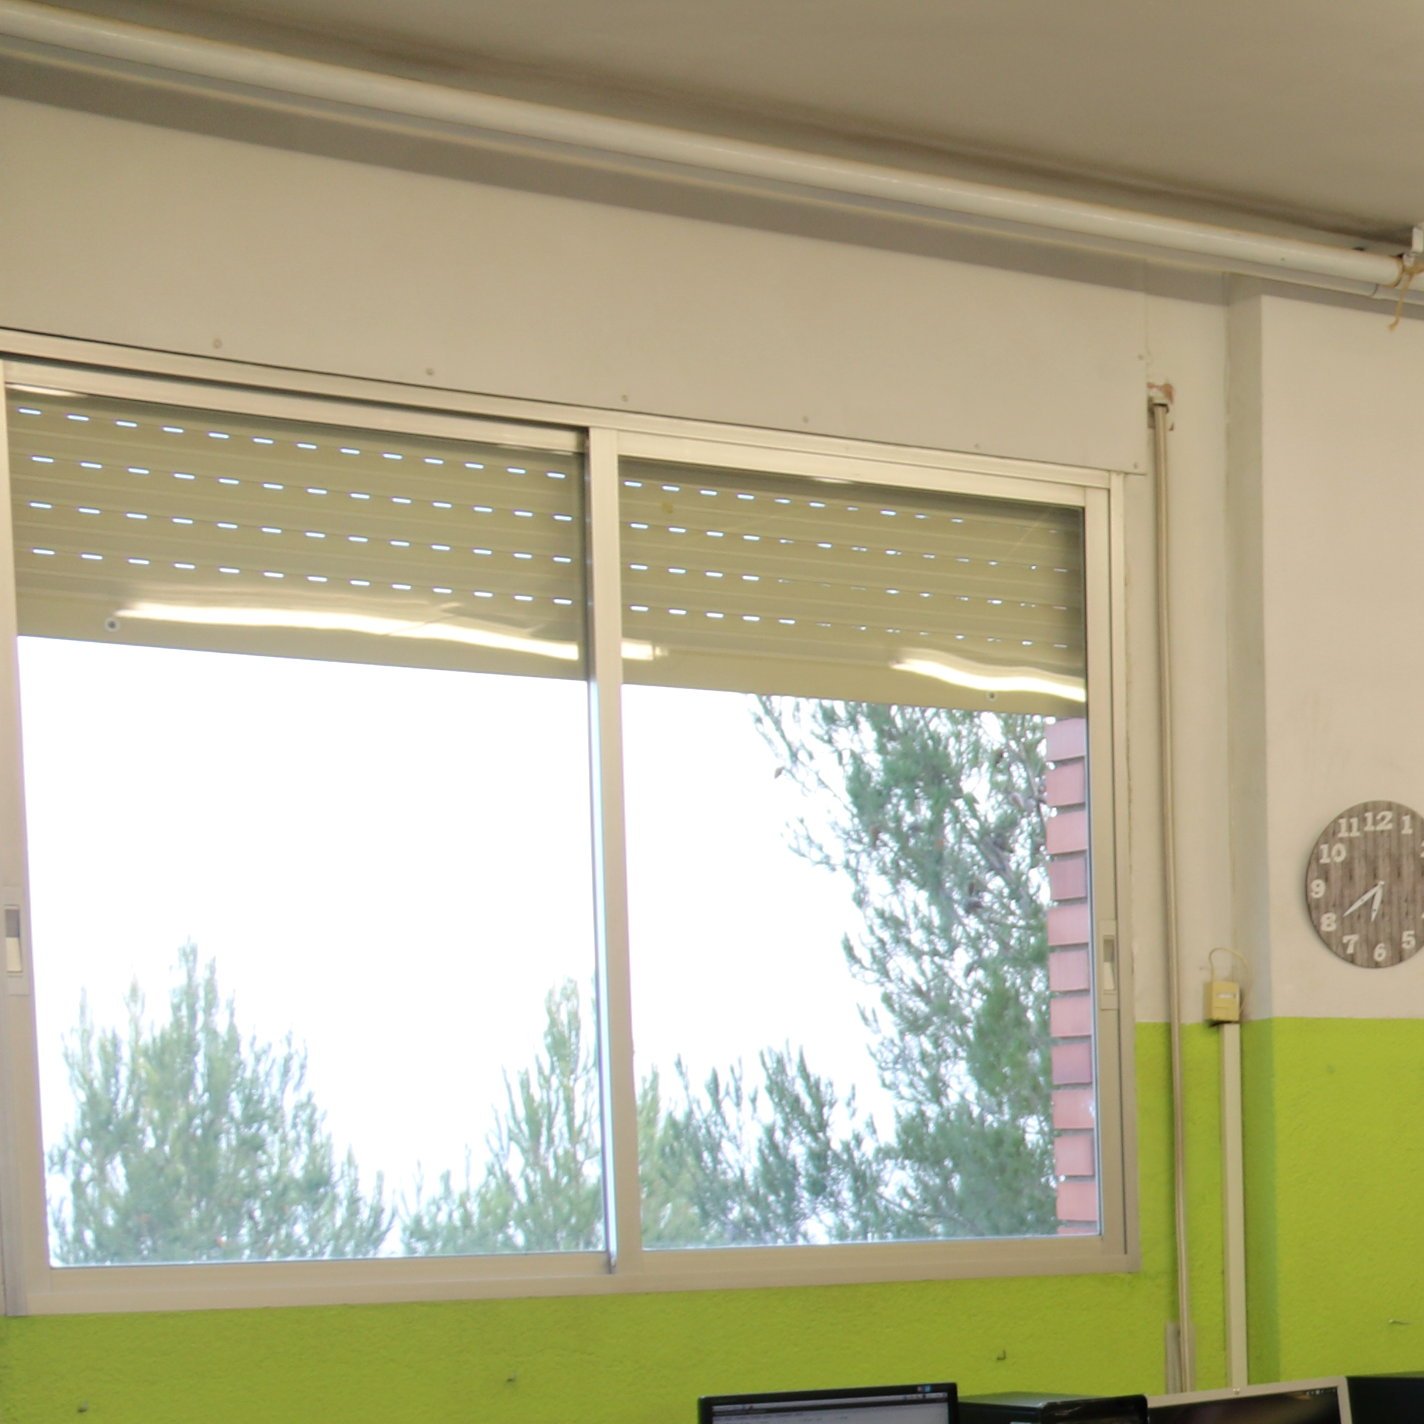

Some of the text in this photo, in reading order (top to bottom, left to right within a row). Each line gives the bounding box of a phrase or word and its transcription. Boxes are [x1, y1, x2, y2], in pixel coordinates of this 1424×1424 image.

[1338, 817, 1361, 837] 11
[1364, 811, 1393, 831] 12
[1401, 815, 1413, 835] 1
[1319, 843, 1346, 863] 10
[1311, 879, 1325, 898] 9
[1320, 912, 1337, 931] 8
[1342, 934, 1359, 954] 7
[1402, 931, 1416, 949] 5
[1374, 943, 1386, 961] 6
